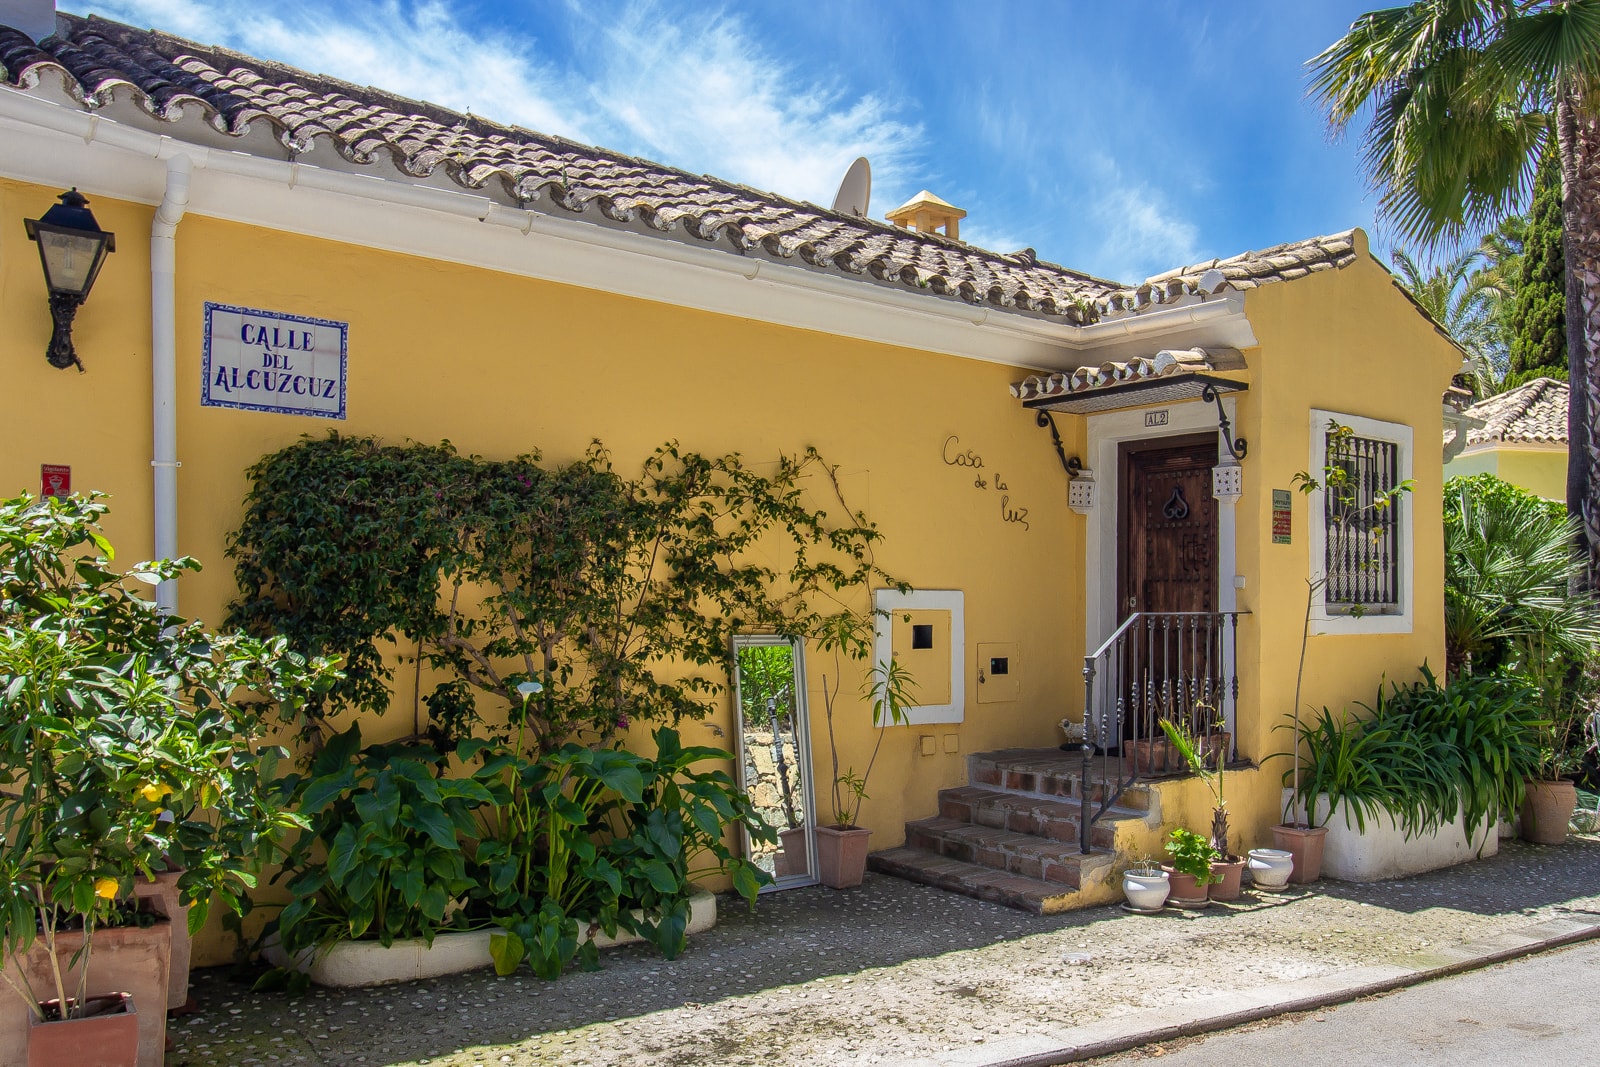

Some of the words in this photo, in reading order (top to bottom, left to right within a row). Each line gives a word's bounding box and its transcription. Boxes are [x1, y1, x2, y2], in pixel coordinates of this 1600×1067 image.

[241, 323, 315, 351] CALLE
[262, 352, 295, 370] DEL
[214, 365, 337, 399] ALCUZCUZ
[943, 435, 985, 469] Casa
[974, 473, 987, 490] de
[995, 473, 1008, 490] la
